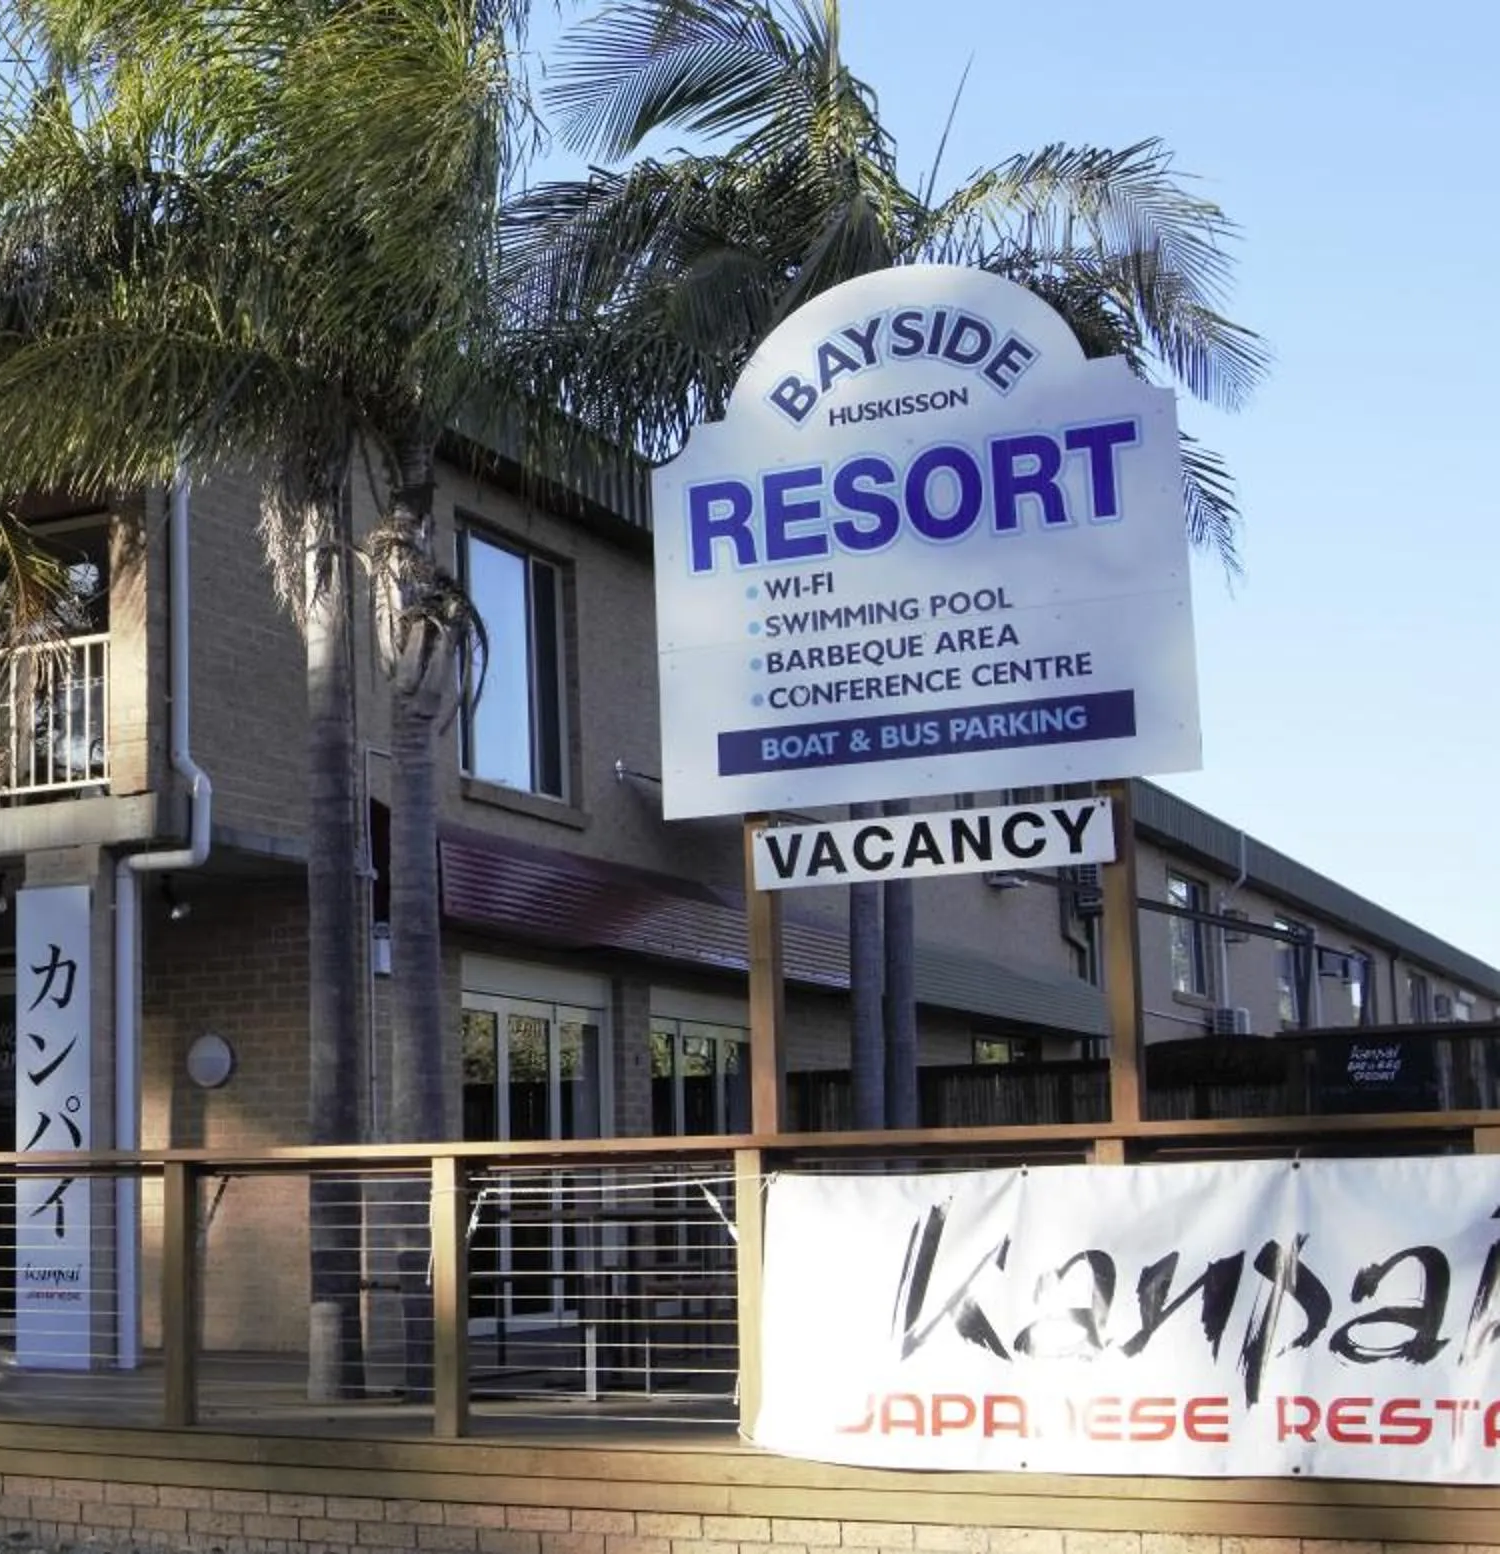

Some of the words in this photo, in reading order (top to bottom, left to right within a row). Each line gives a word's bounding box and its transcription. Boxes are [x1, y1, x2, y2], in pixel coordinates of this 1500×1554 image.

[770, 311, 1033, 421] BAYSIDE
[829, 387, 968, 426] HUSKISSON
[689, 421, 1136, 572] RESORT
[764, 572, 833, 600] WI-FI
[766, 598, 919, 637] SWIMMING
[930, 587, 1013, 617] POOL
[767, 635, 923, 674] BARBEQUE
[935, 624, 1020, 654] AREA
[769, 671, 961, 709] CONFERENCE
[972, 652, 1093, 686] CENTRE
[761, 731, 840, 760] BOAT
[850, 729, 871, 752] &
[881, 721, 940, 749] BUS
[950, 706, 1088, 743] PARKING
[766, 806, 1095, 879] VACANCY
[24, 943, 82, 1239] カンパイ
[835, 1394, 1229, 1443] JAPAESE
